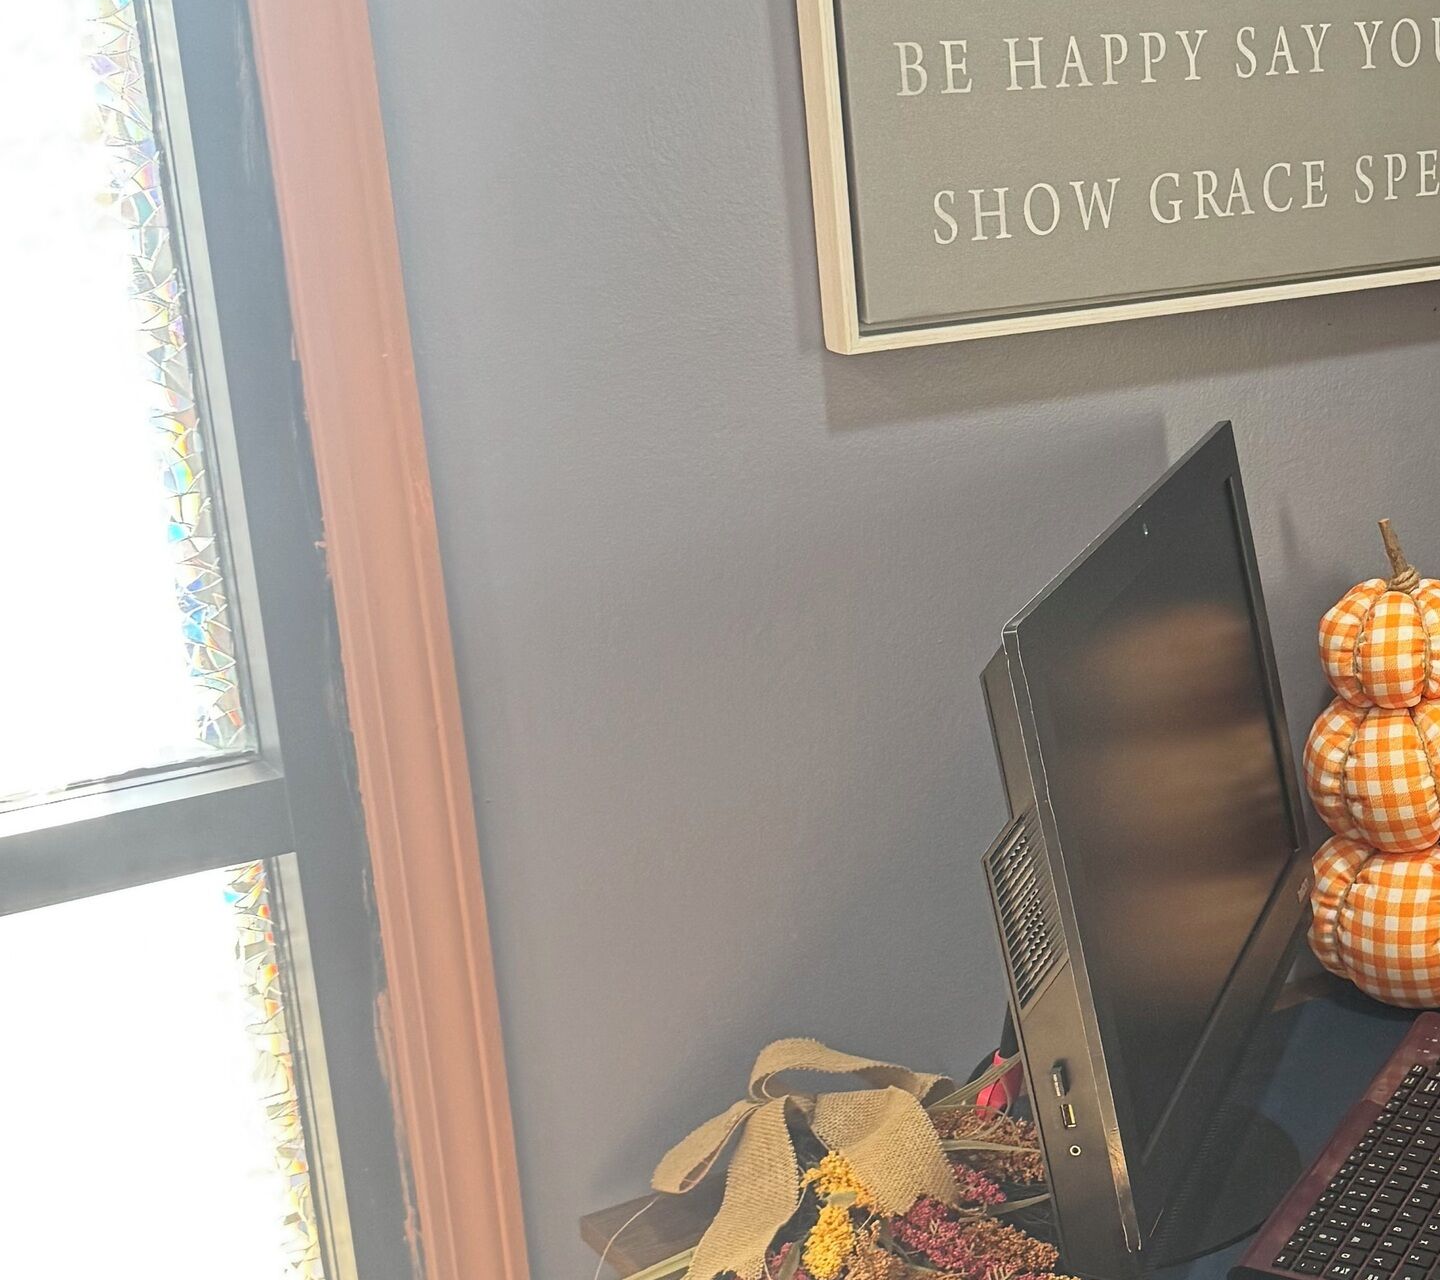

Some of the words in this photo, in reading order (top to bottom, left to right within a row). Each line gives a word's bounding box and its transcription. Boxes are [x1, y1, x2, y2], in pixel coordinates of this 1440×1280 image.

[893, 40, 972, 96] BE
[1003, 30, 1208, 90] HAPPY
[1236, 23, 1332, 78] SAY
[934, 178, 1120, 244] SHOW
[1150, 160, 1328, 223] GRACE
